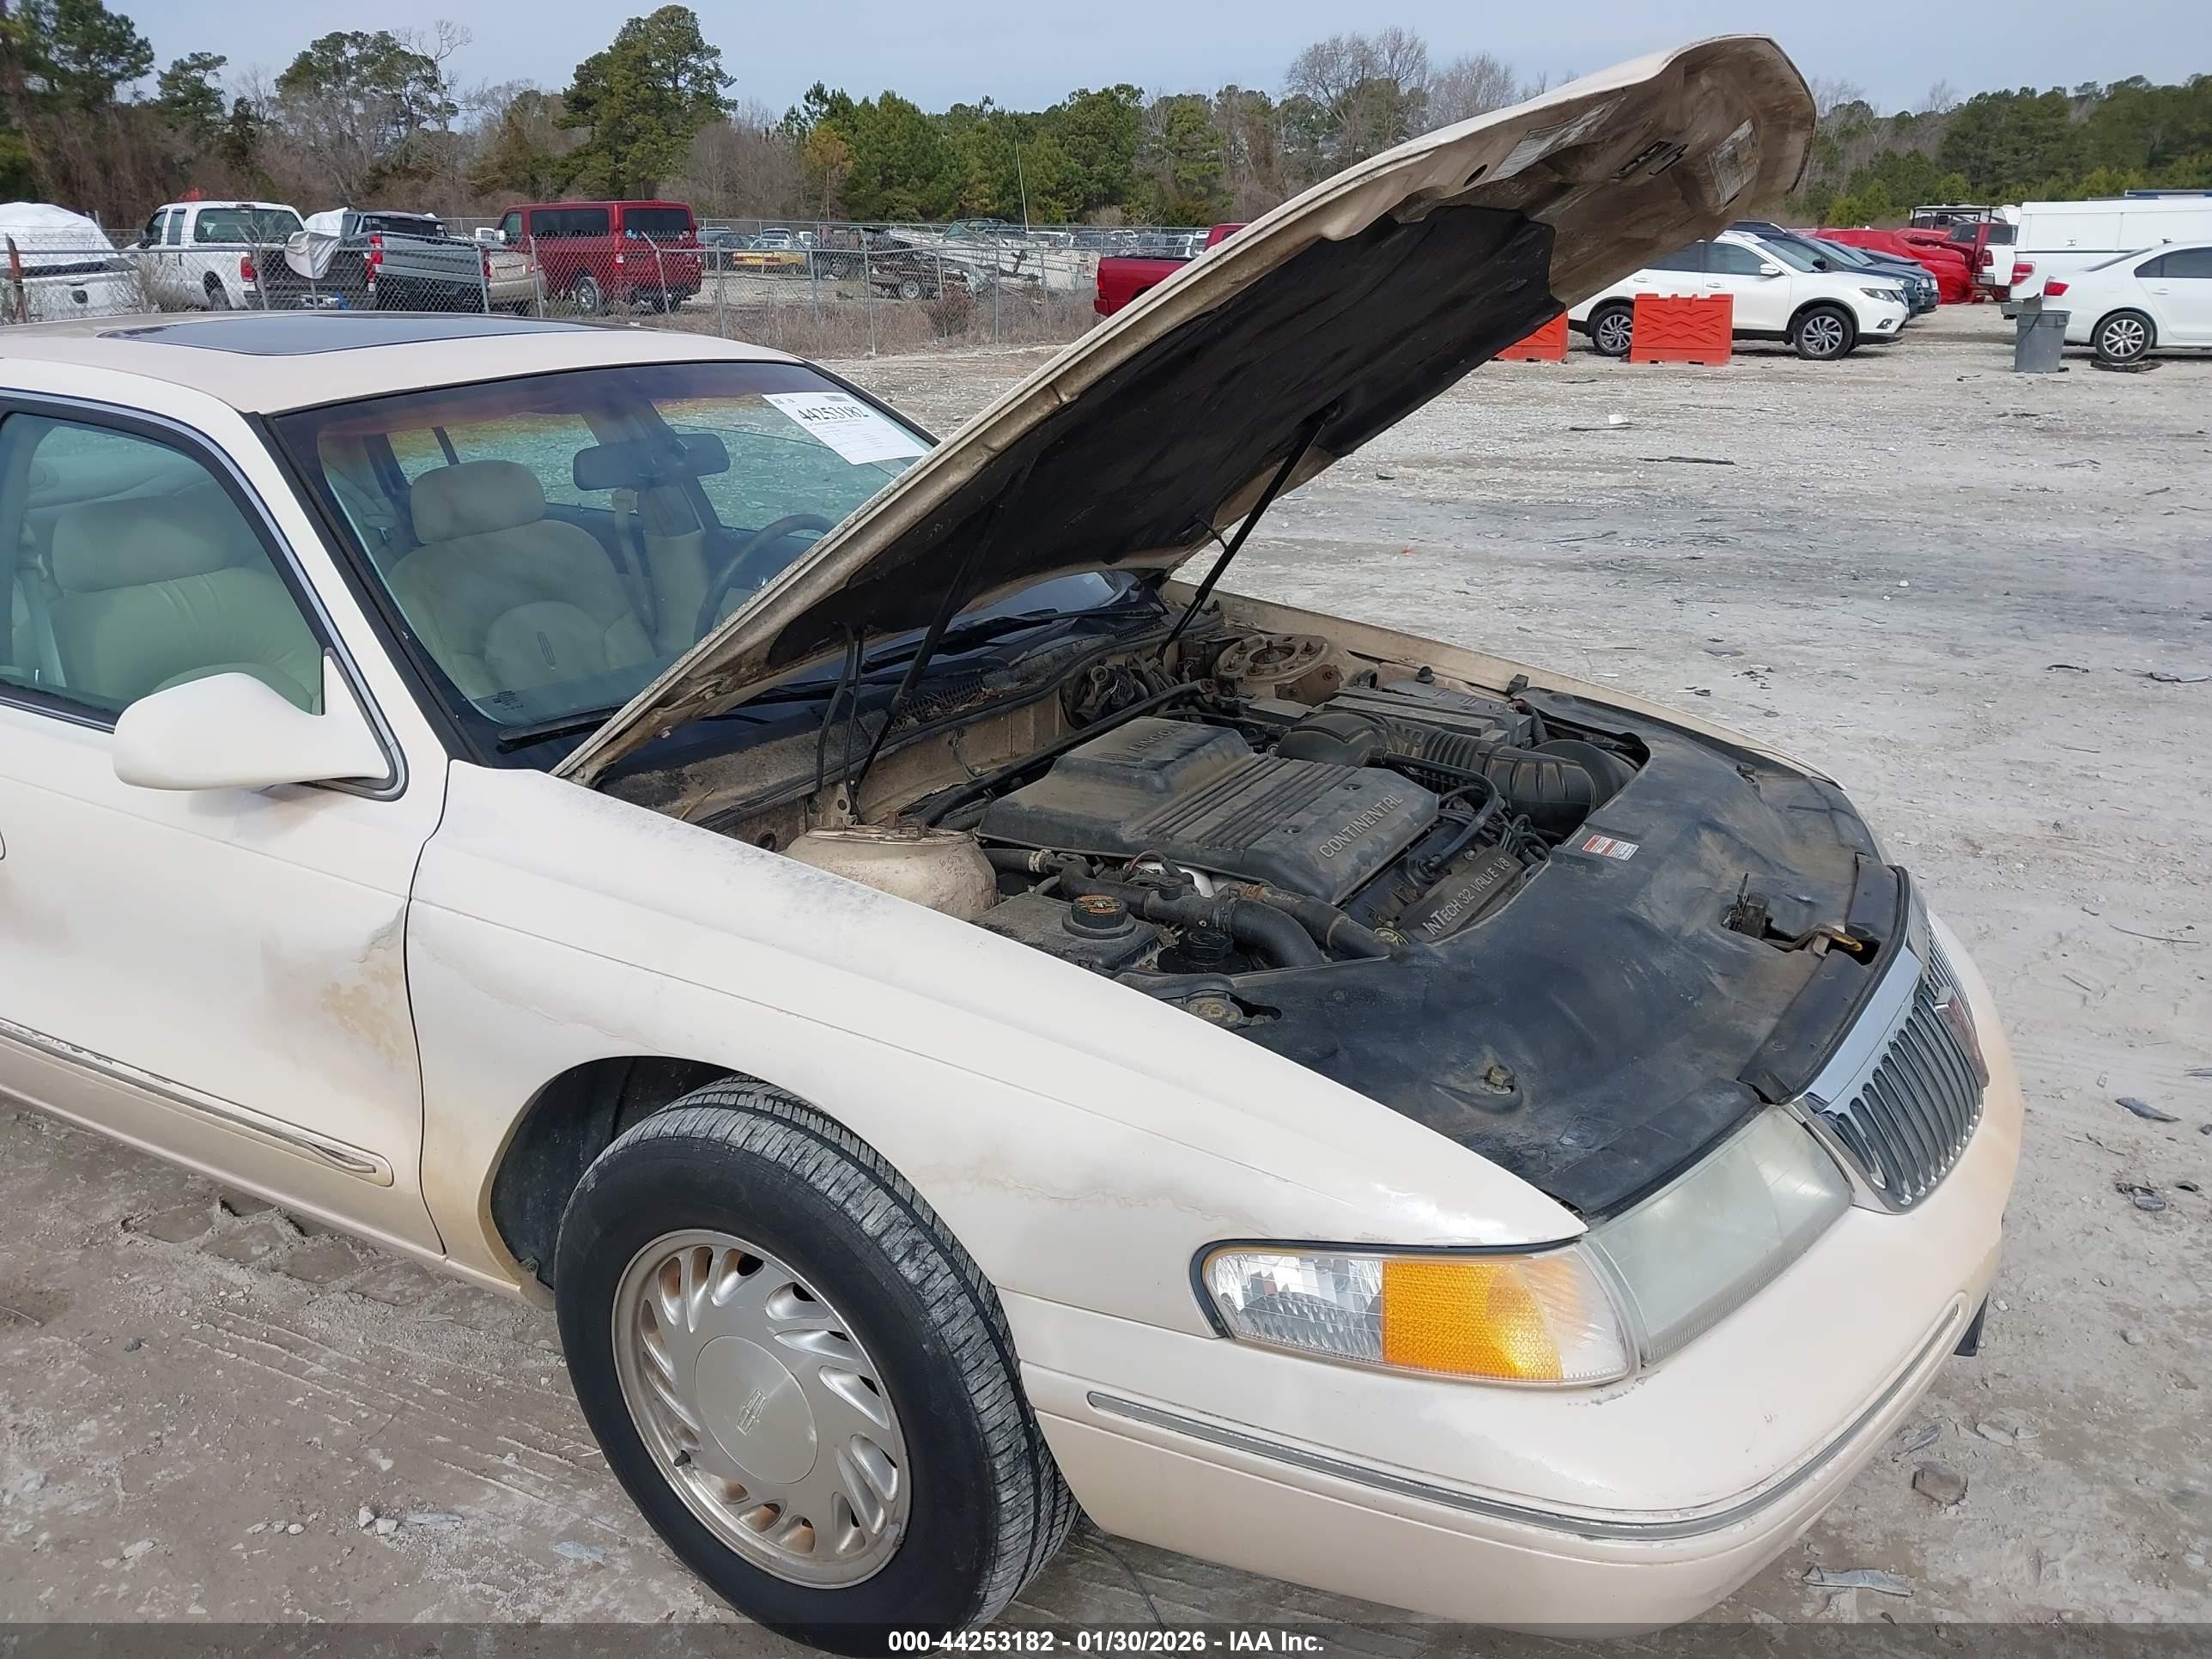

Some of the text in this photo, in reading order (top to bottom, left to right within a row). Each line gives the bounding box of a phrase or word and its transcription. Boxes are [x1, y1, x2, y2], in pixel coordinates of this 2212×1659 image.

[797, 406, 869, 422] 44253182
[1318, 793, 1403, 858] CONTINENTAL
[1458, 888, 1475, 904] 32
[1470, 866, 1499, 892] VALVE
[1494, 857, 1510, 871] V8
